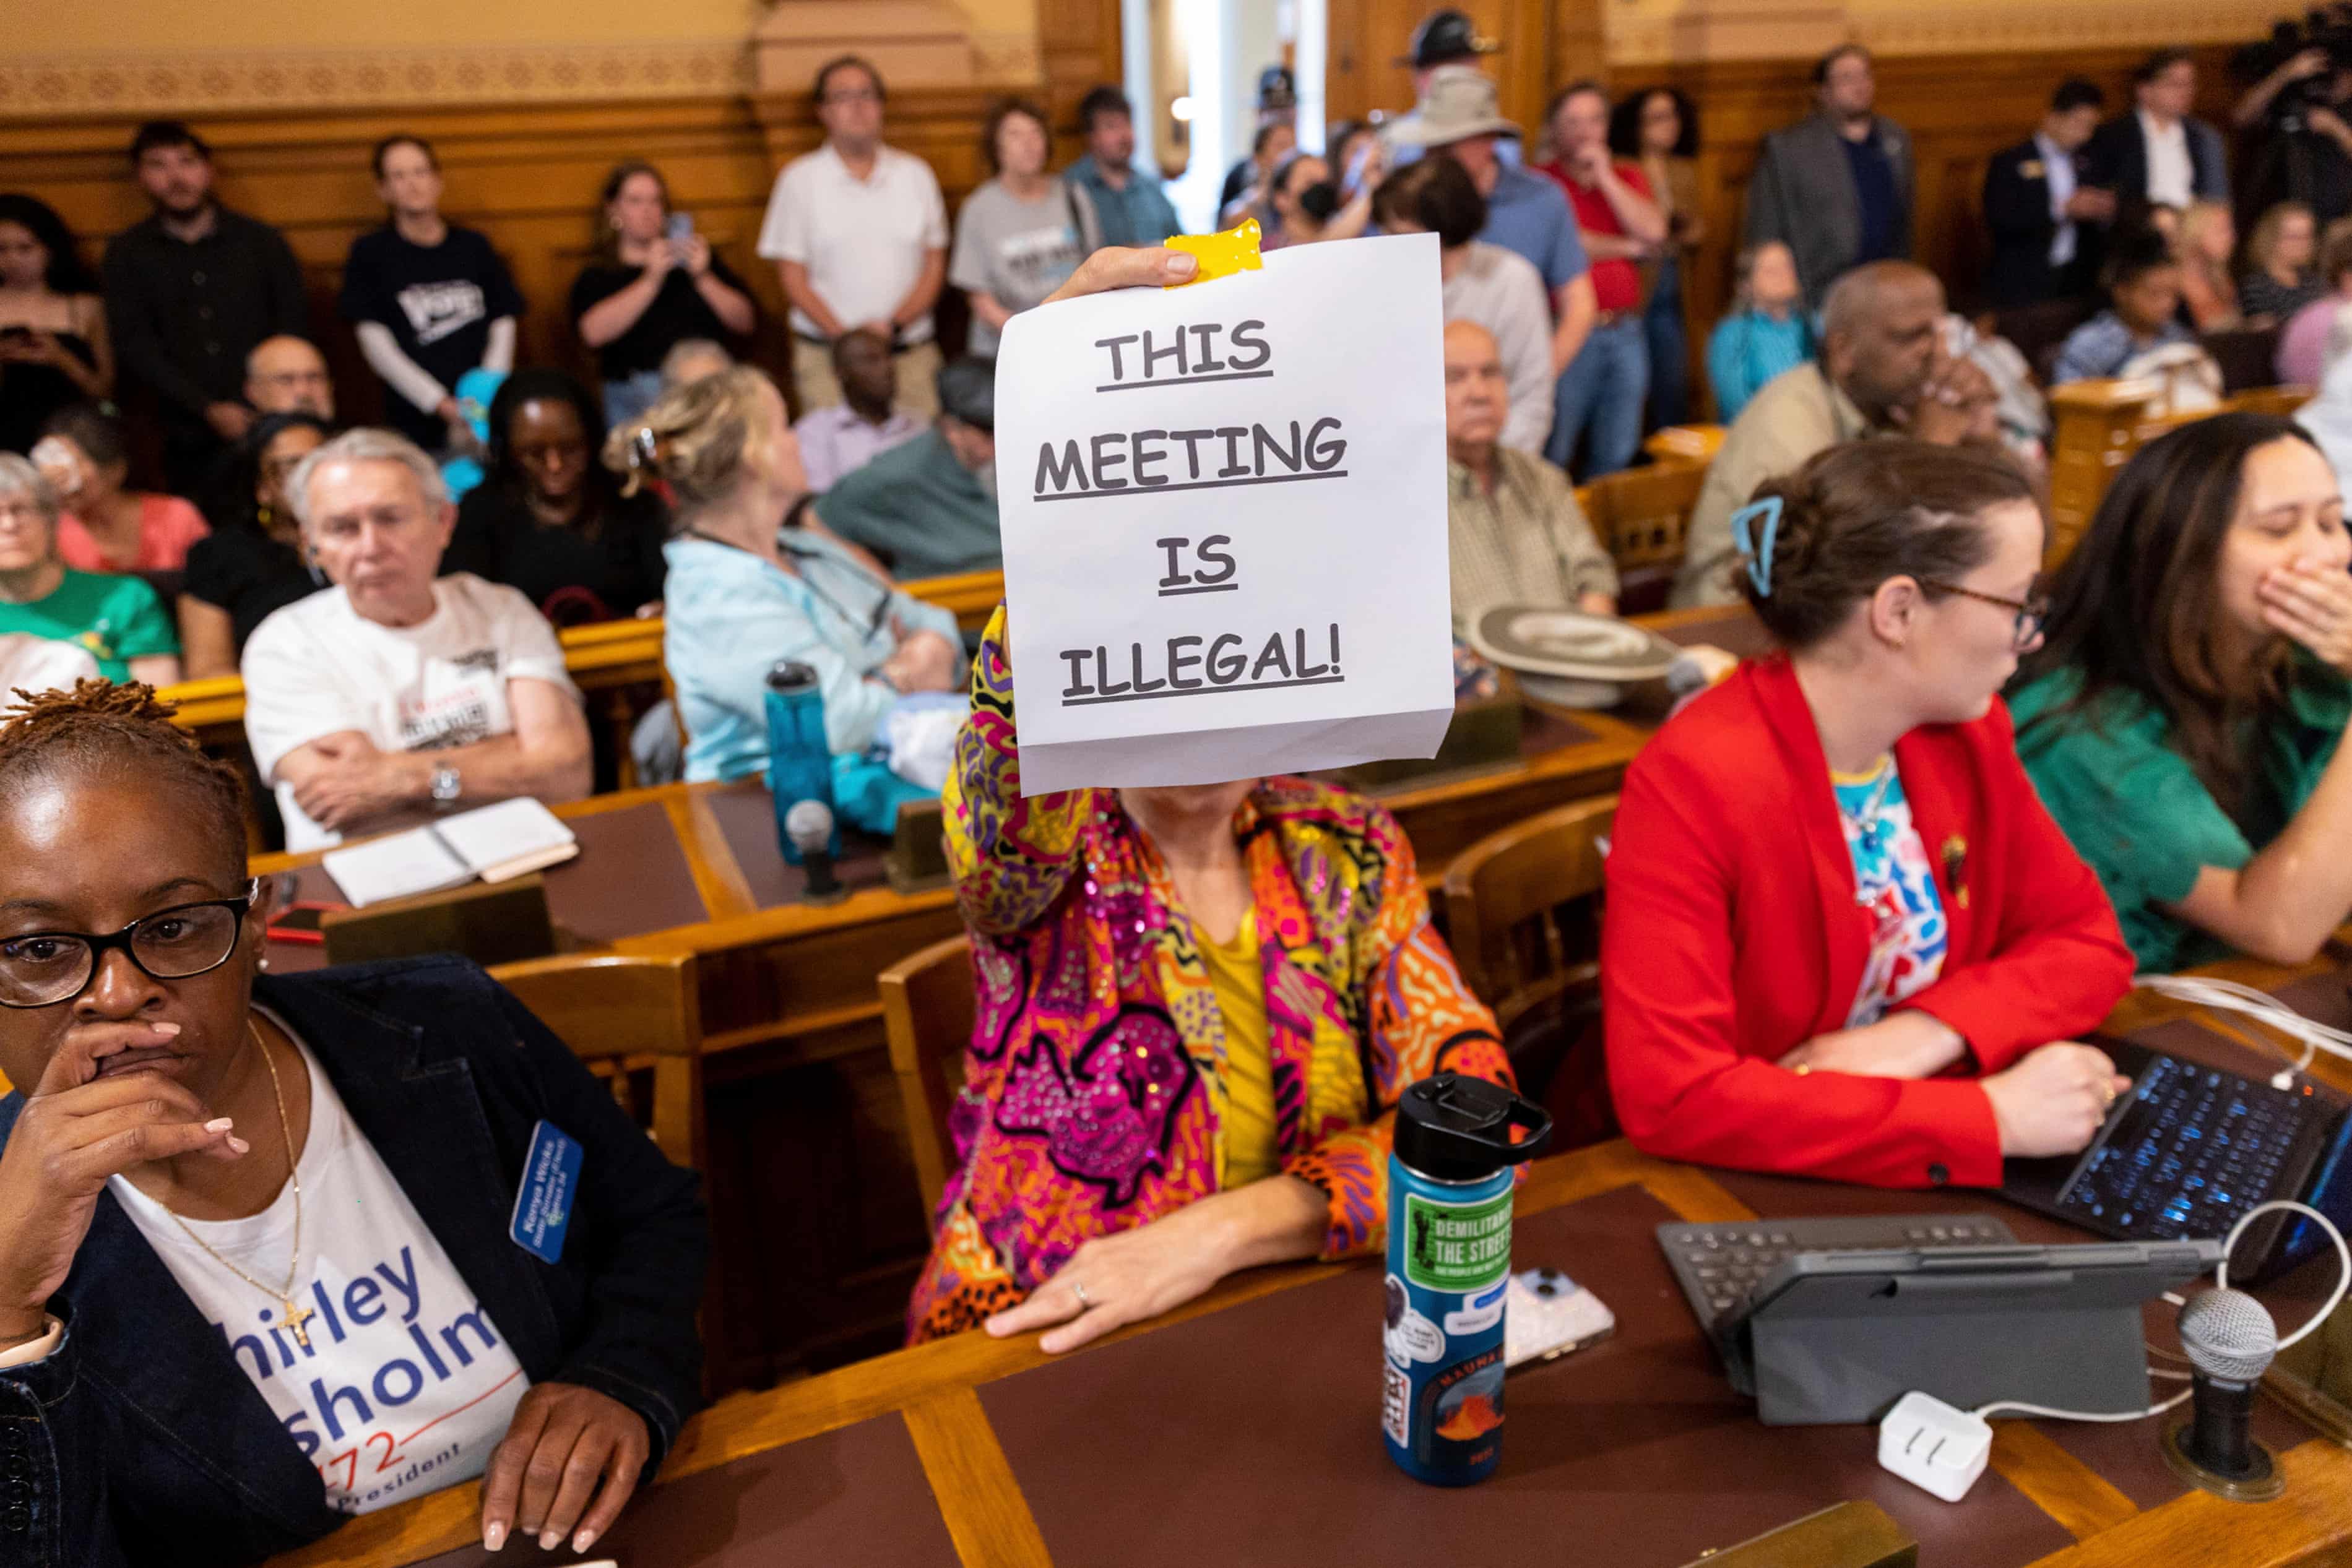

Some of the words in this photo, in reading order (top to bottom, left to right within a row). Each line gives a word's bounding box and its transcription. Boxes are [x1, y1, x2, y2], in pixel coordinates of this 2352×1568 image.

[1094, 319, 1272, 381] THIS
[1034, 416, 1348, 495] MEETING
[1156, 534, 1237, 588] IS
[1060, 622, 1343, 698] ILLEGAL!
[1434, 1240, 1465, 1264] THE
[337, 1442, 459, 1511] President
